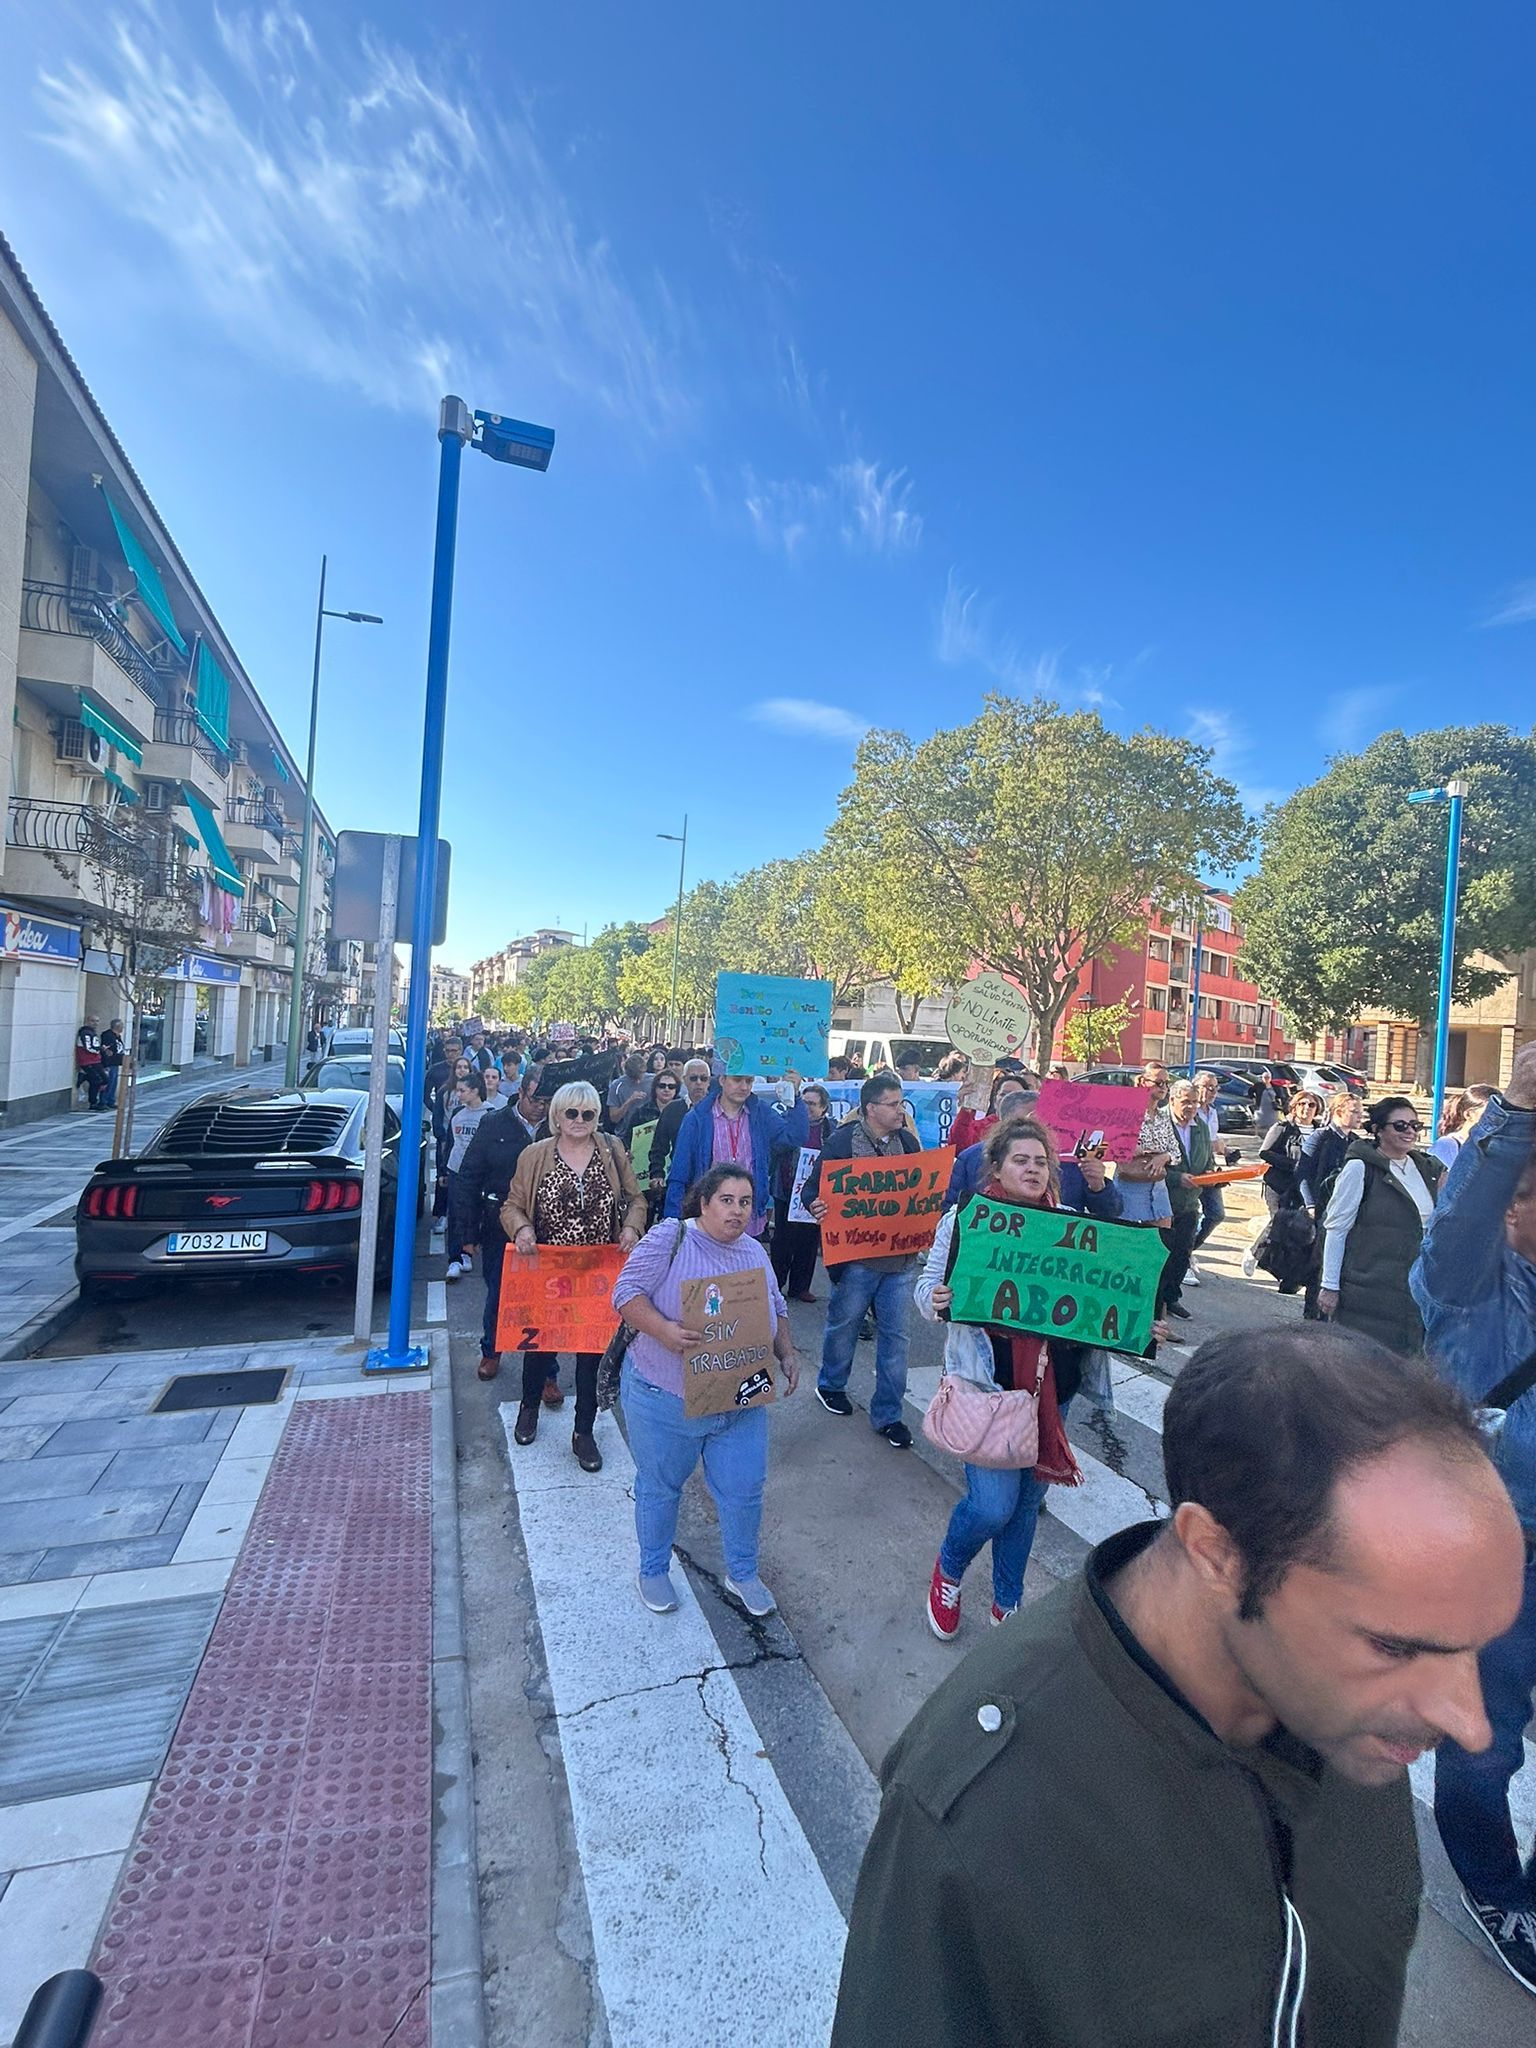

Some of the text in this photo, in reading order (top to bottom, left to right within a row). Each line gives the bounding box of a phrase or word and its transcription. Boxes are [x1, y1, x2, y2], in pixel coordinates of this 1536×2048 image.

[973, 986, 1001, 1001] SALUD
[1002, 989, 1014, 999] LA
[962, 1000, 983, 1018] NO
[976, 1022, 994, 1036] TUS
[827, 1164, 922, 1195] TRABAJO
[841, 1198, 900, 1218] SALUD
[968, 1204, 1025, 1238] POR
[180, 1233, 262, 1250] 7032 LNC
[1052, 1220, 1098, 1253] LA
[986, 1247, 1142, 1297] INTEGRACIÓN
[956, 1275, 1141, 1348] LABORAL
[689, 1345, 769, 1375] TRABAJO
